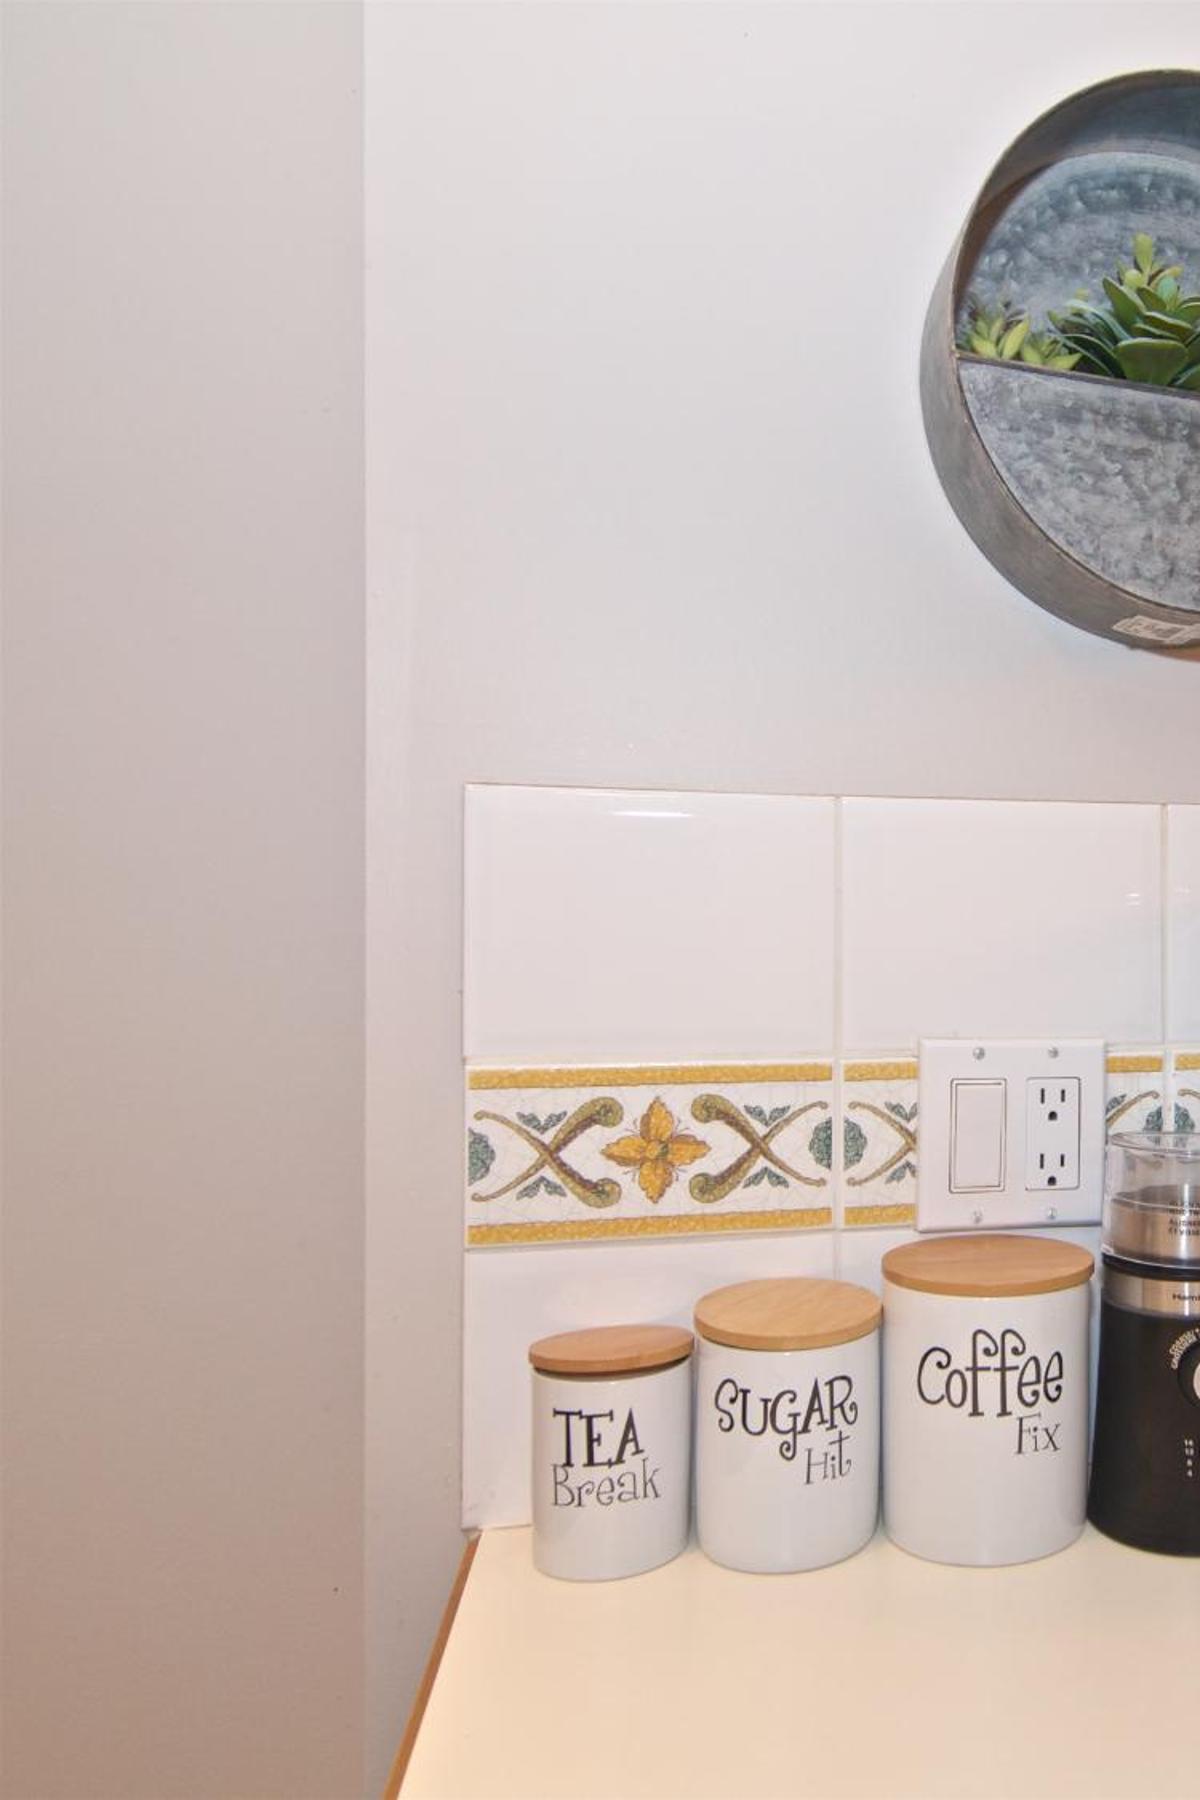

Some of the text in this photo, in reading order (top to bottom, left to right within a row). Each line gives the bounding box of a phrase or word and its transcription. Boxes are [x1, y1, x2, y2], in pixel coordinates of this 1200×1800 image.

[917, 1329, 1064, 1417] Coffee
[553, 1408, 645, 1468] TEA
[714, 1375, 858, 1461] SUGAR
[1013, 1412, 1062, 1455] Fix
[552, 1459, 660, 1507] Break
[804, 1431, 852, 1485] Hit
